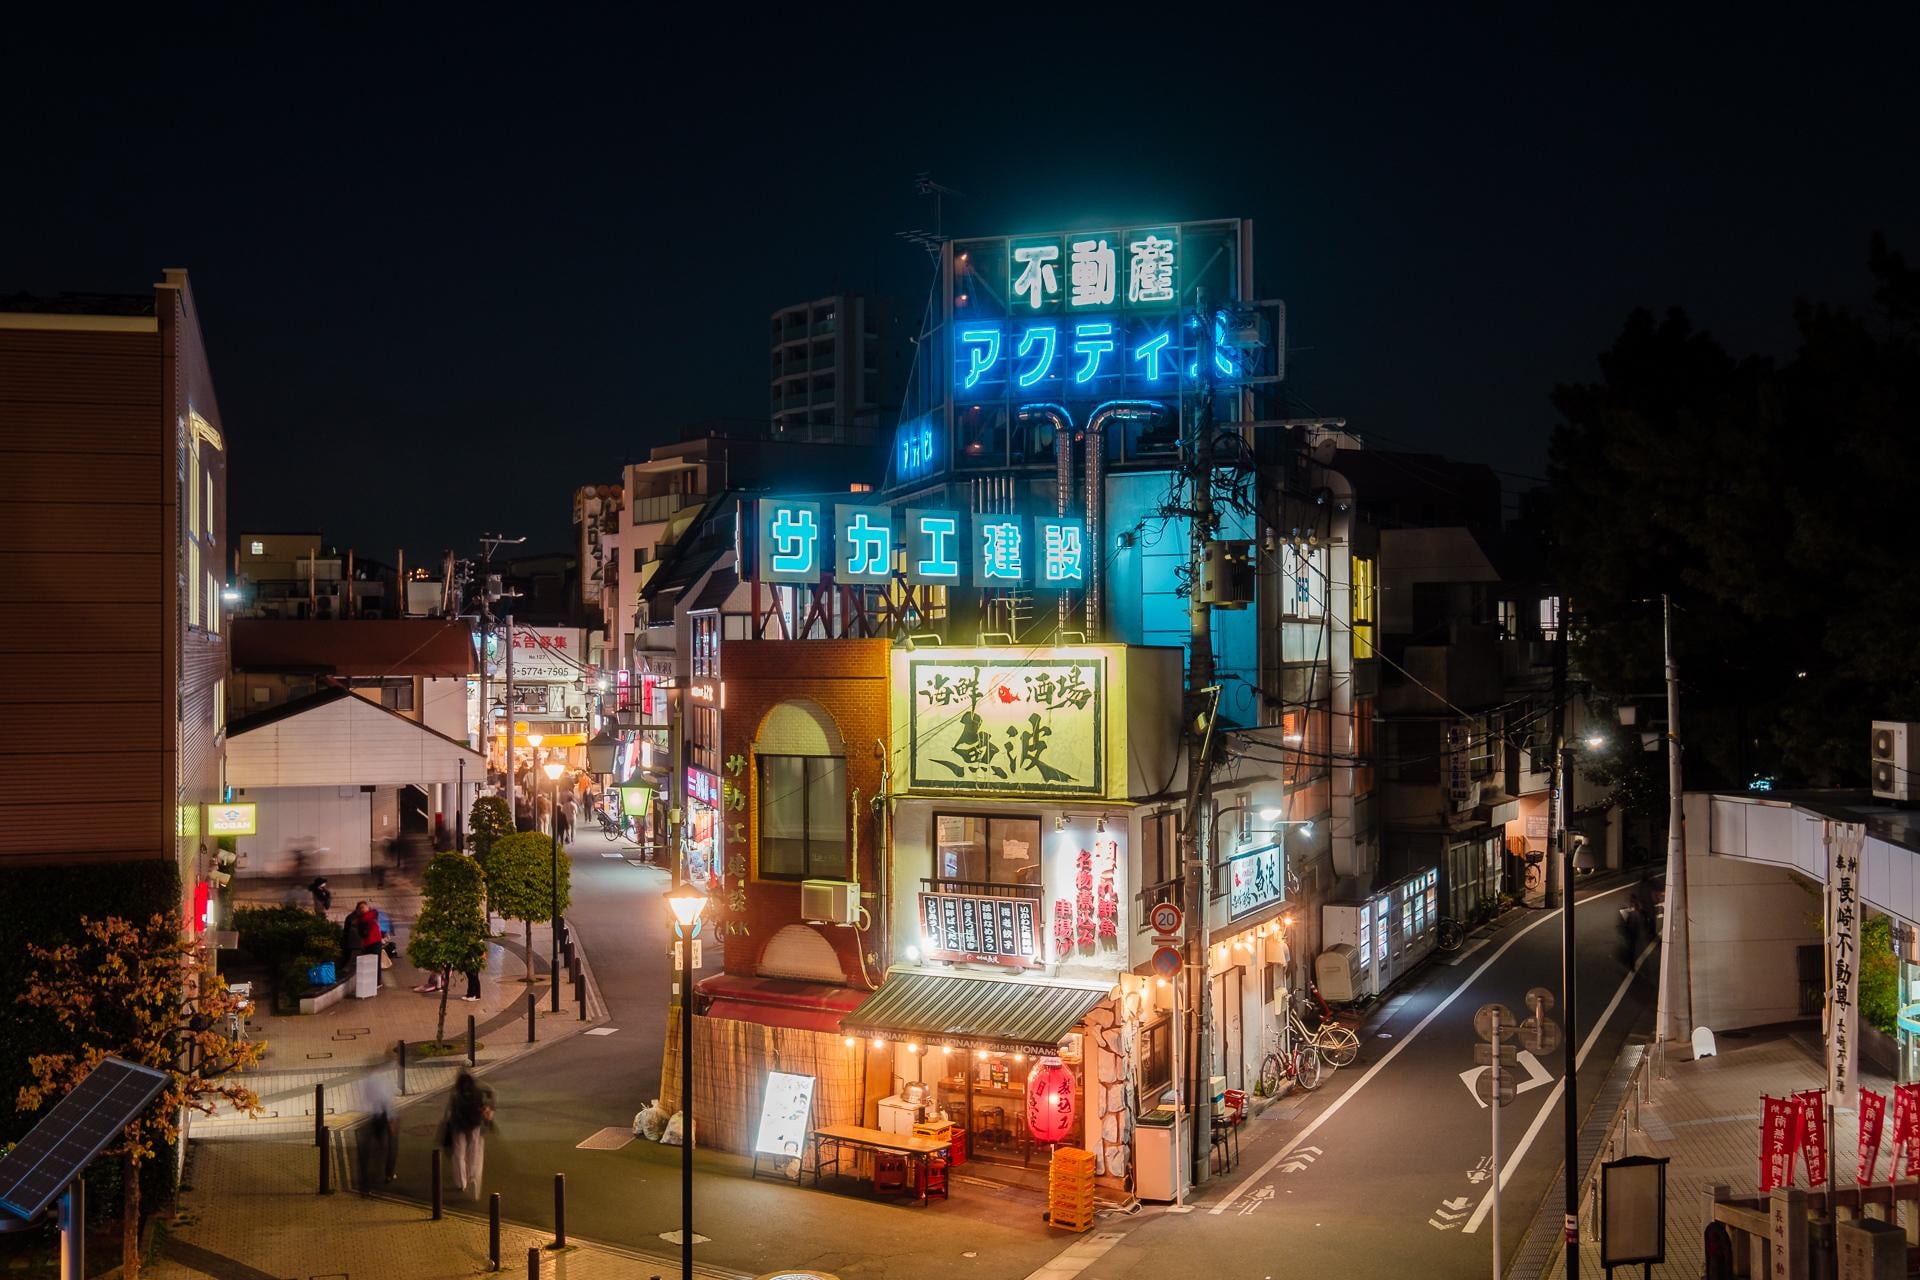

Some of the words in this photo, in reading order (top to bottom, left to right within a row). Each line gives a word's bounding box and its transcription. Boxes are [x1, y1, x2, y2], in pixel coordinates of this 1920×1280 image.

[1013, 235, 1174, 309] 不動産
[772, 509, 1082, 581] サカエ建設
[512, 667, 569, 676] 3-5774-7505
[919, 667, 984, 717] 海鮮
[1024, 665, 1096, 711] 酒場
[929, 711, 1081, 783] 魚波
[726, 754, 748, 912] サカエ建設
[1836, 853, 1858, 873] 奉納
[1076, 848, 1095, 947] 名物煮込み
[1096, 841, 1118, 937] れ鮮魚
[1158, 912, 1175, 926] 20
[1054, 899, 1074, 957] 串揚げ
[1834, 876, 1856, 1011] 長崎不動尊
[870, 1031, 910, 1042] UONAMI
[941, 1038, 982, 1048] UONAMI
[1001, 1044, 1016, 1052] BAR
